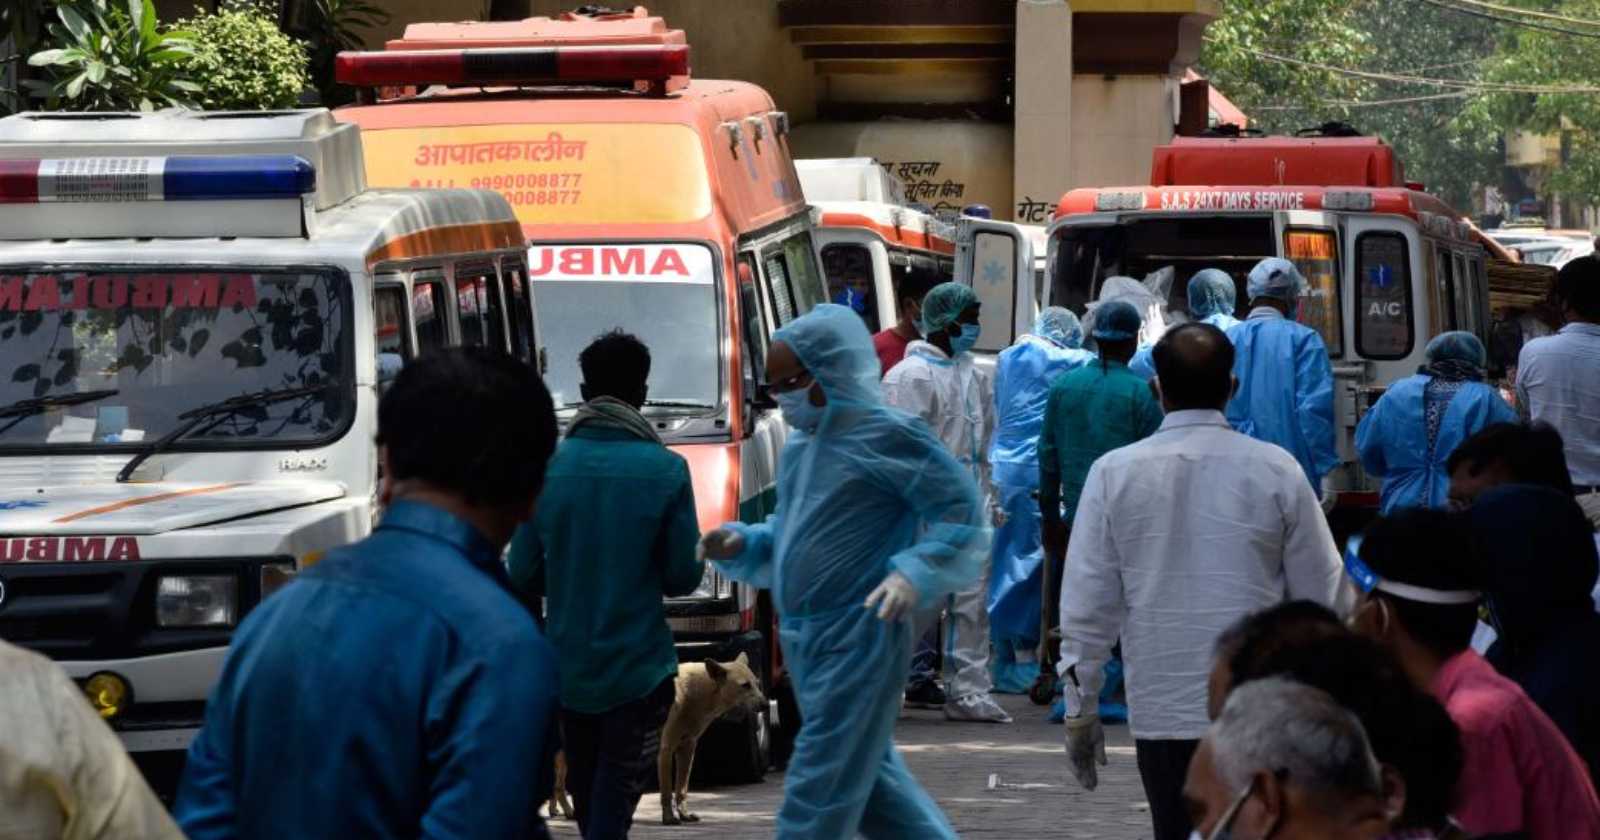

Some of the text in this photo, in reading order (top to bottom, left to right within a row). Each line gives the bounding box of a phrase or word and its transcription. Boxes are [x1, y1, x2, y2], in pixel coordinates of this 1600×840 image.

[415, 132, 587, 166] आपातकालीन
[898, 162, 940, 182] सूचना
[1017, 196, 1048, 223] गेट
[1254, 192, 1304, 209] SERVICE
[1368, 302, 1401, 316] A/C
